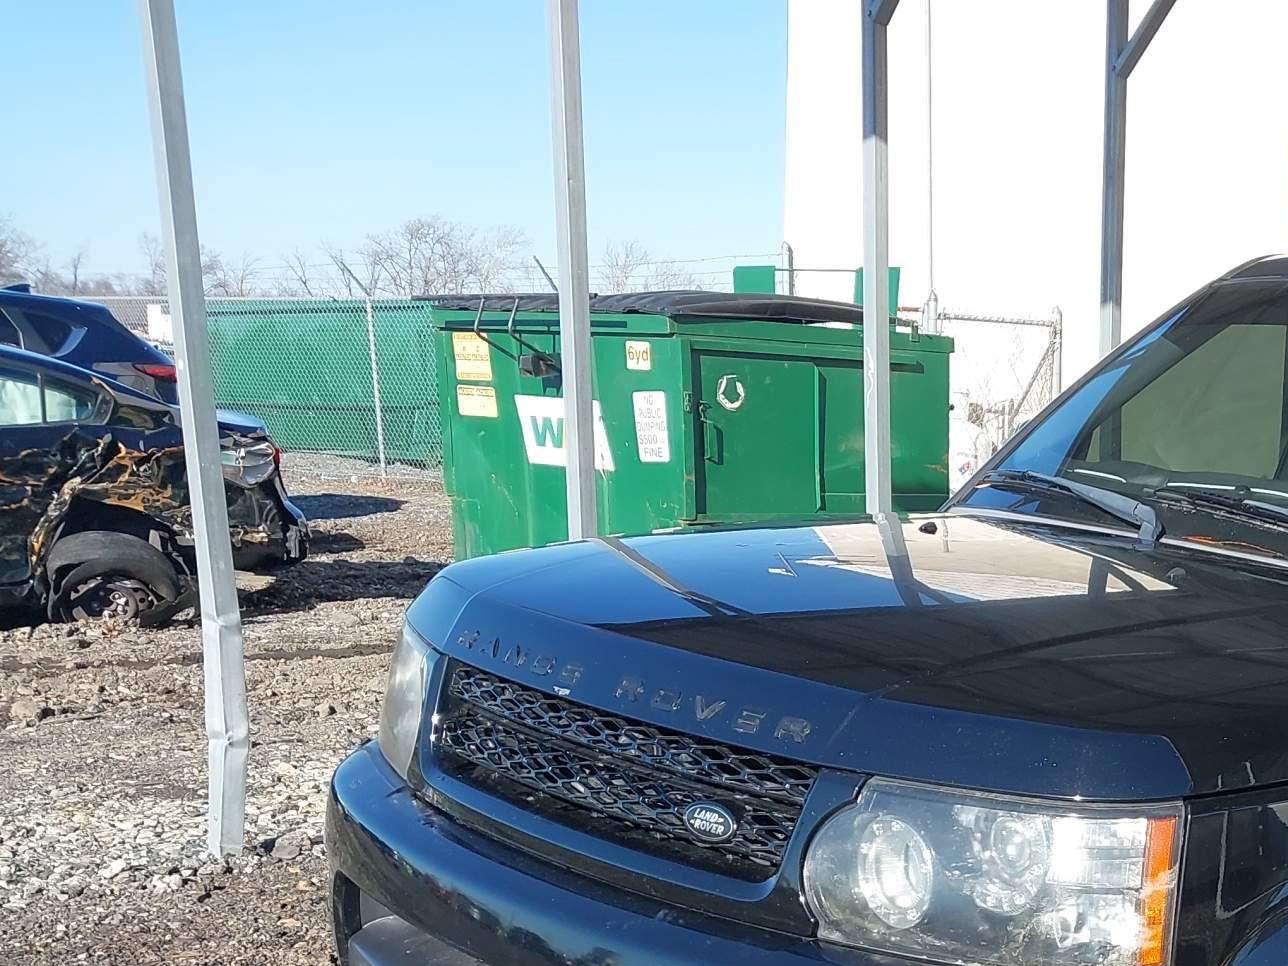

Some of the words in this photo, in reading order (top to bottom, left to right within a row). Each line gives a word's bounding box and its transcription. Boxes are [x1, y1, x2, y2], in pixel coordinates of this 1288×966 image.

[627, 345, 649, 364] 6yd
[638, 407, 661, 418] PUBLIC
[637, 420, 666, 432] DUMPING
[643, 447, 664, 458] FINE
[615, 676, 813, 743] ROVER
[693, 808, 719, 822] LAND
[693, 818, 725, 835] ROVER
